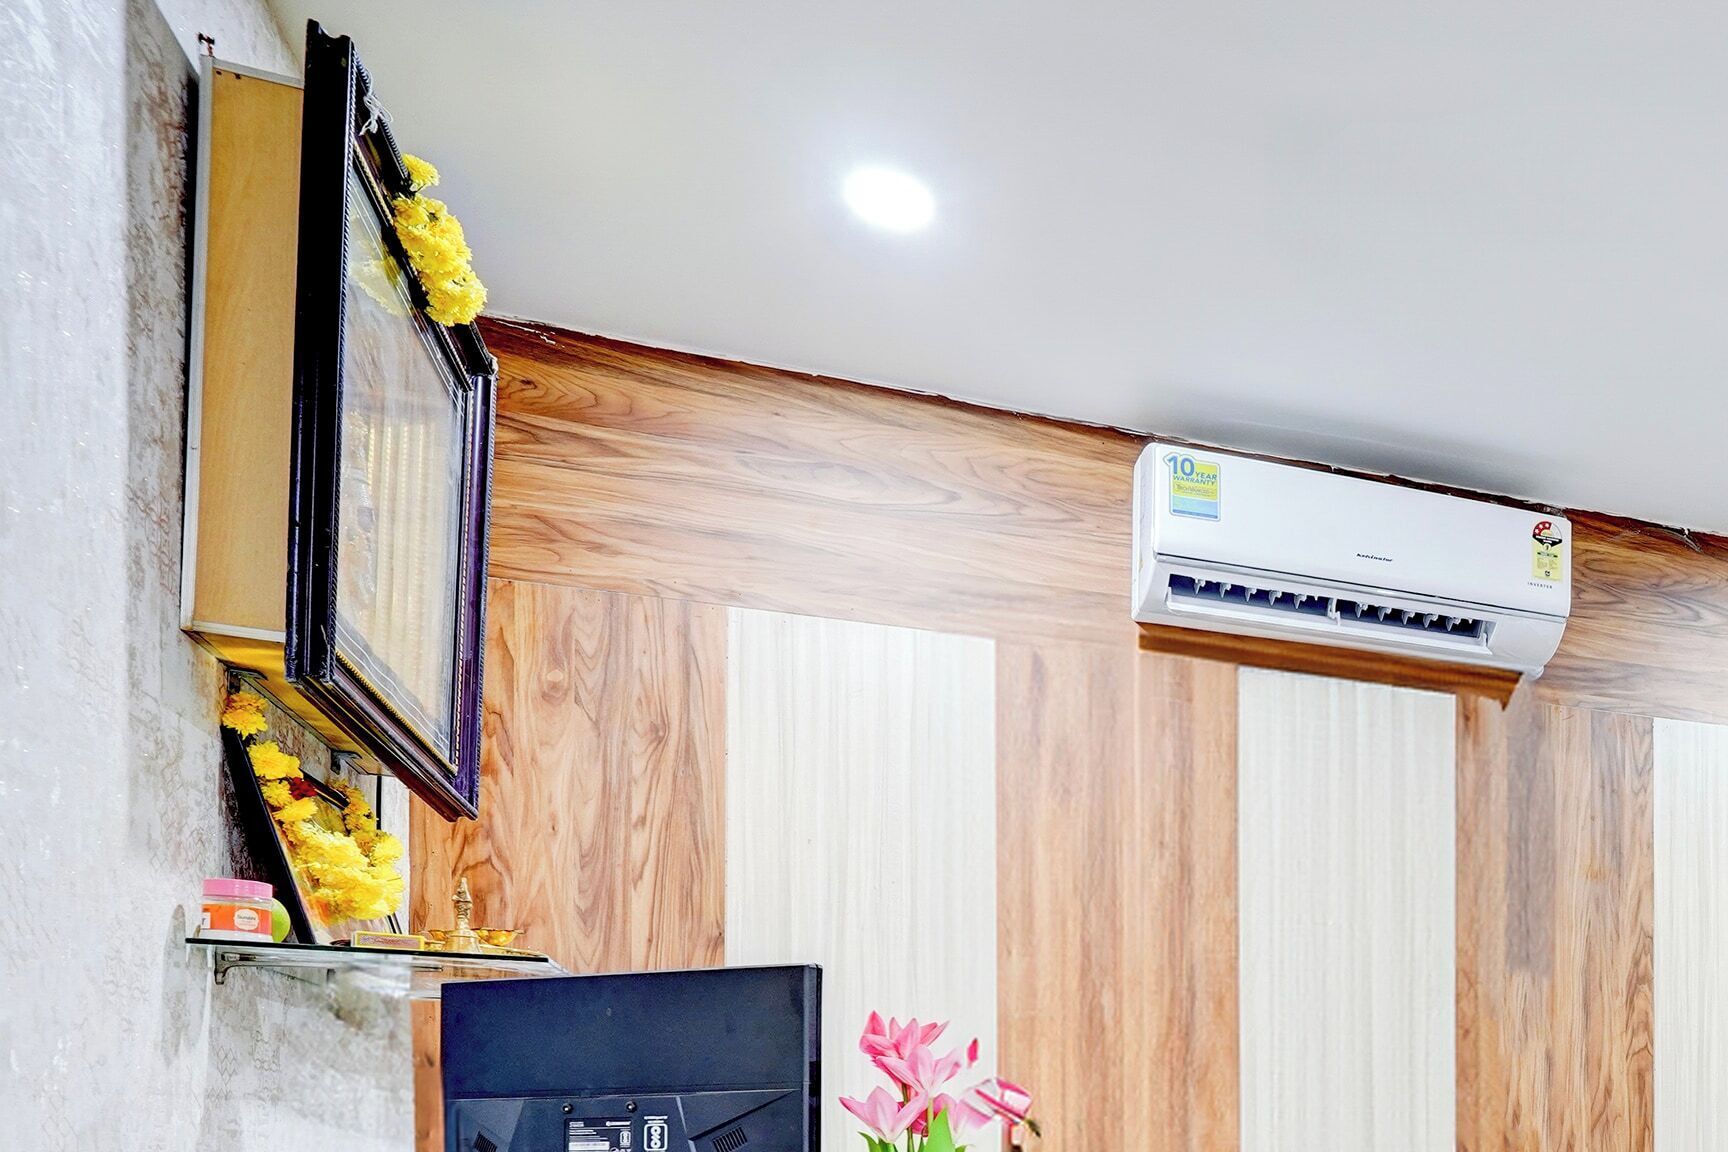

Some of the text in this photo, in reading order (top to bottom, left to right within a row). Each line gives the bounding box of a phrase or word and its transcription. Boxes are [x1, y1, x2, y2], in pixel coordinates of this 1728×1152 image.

[1167, 455, 1217, 481] 10 YEAR
[1173, 474, 1215, 486] WARRANTY
